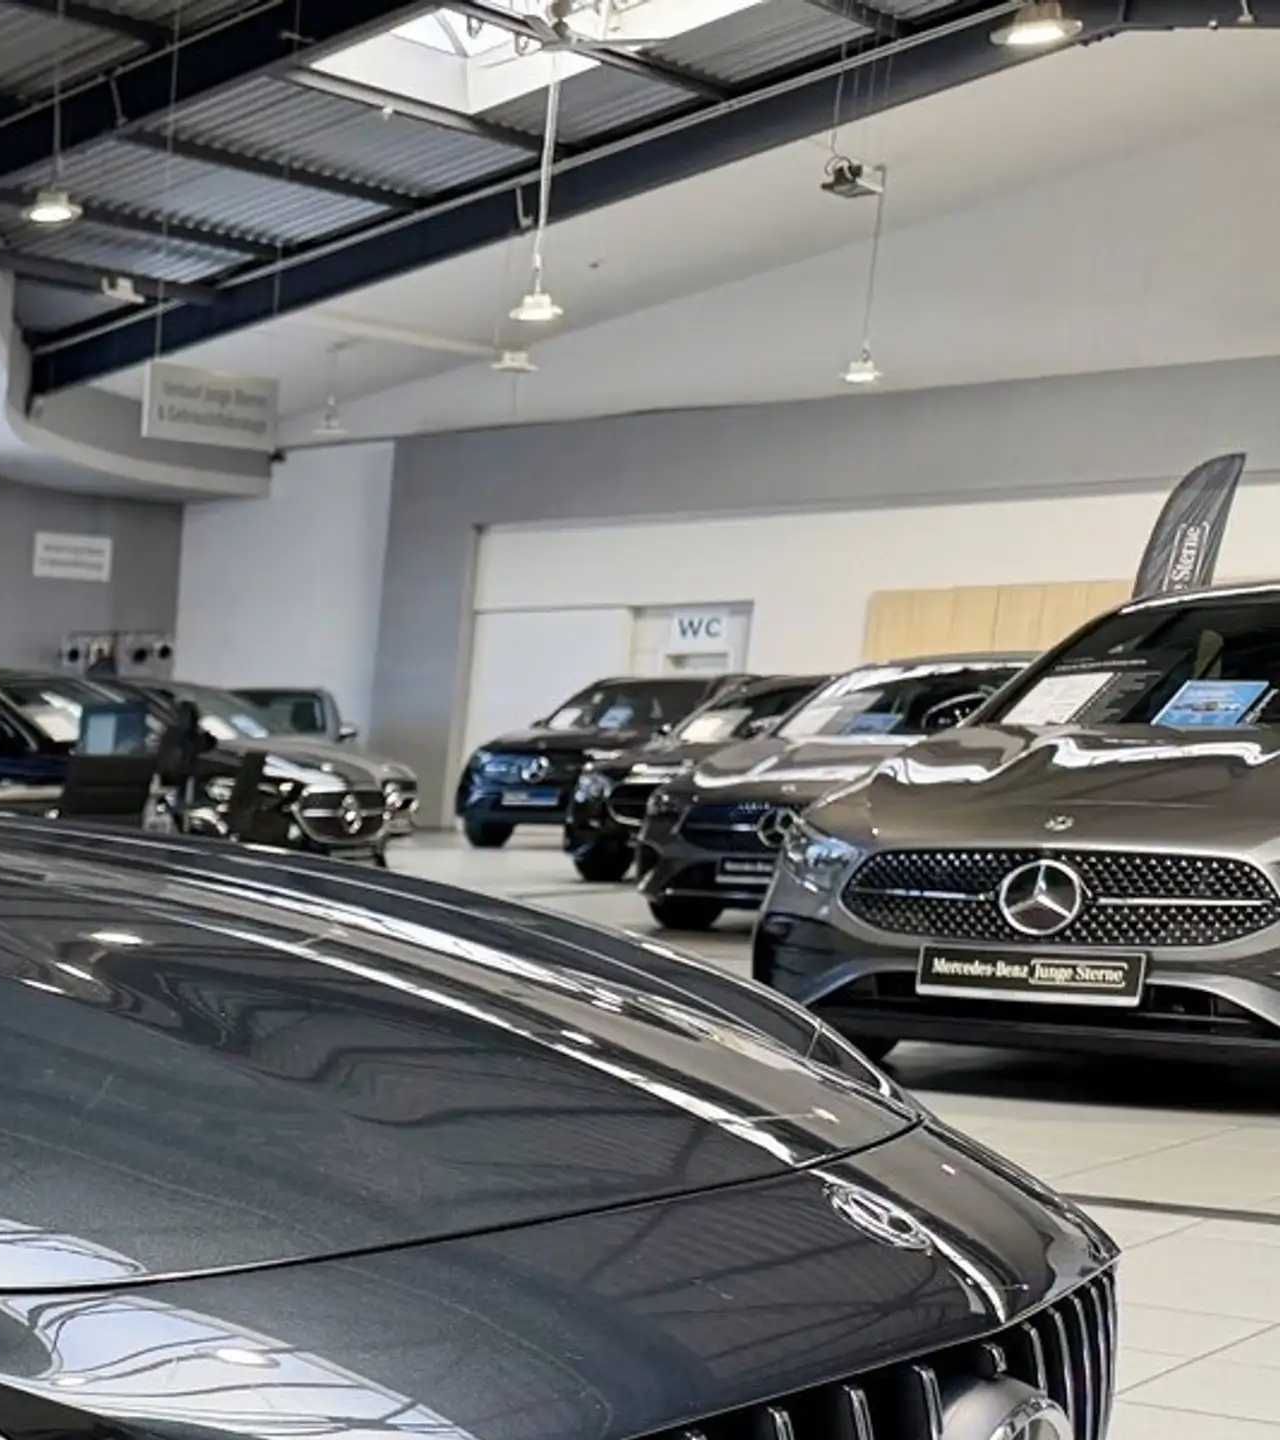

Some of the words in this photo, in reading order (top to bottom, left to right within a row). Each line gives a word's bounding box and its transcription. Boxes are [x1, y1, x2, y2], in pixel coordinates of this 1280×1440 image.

[678, 617, 722, 639] WC
[932, 957, 1028, 979] Mercedes-Benz
[1034, 963, 1074, 982] Junge
[1075, 966, 1124, 983] Sterne
